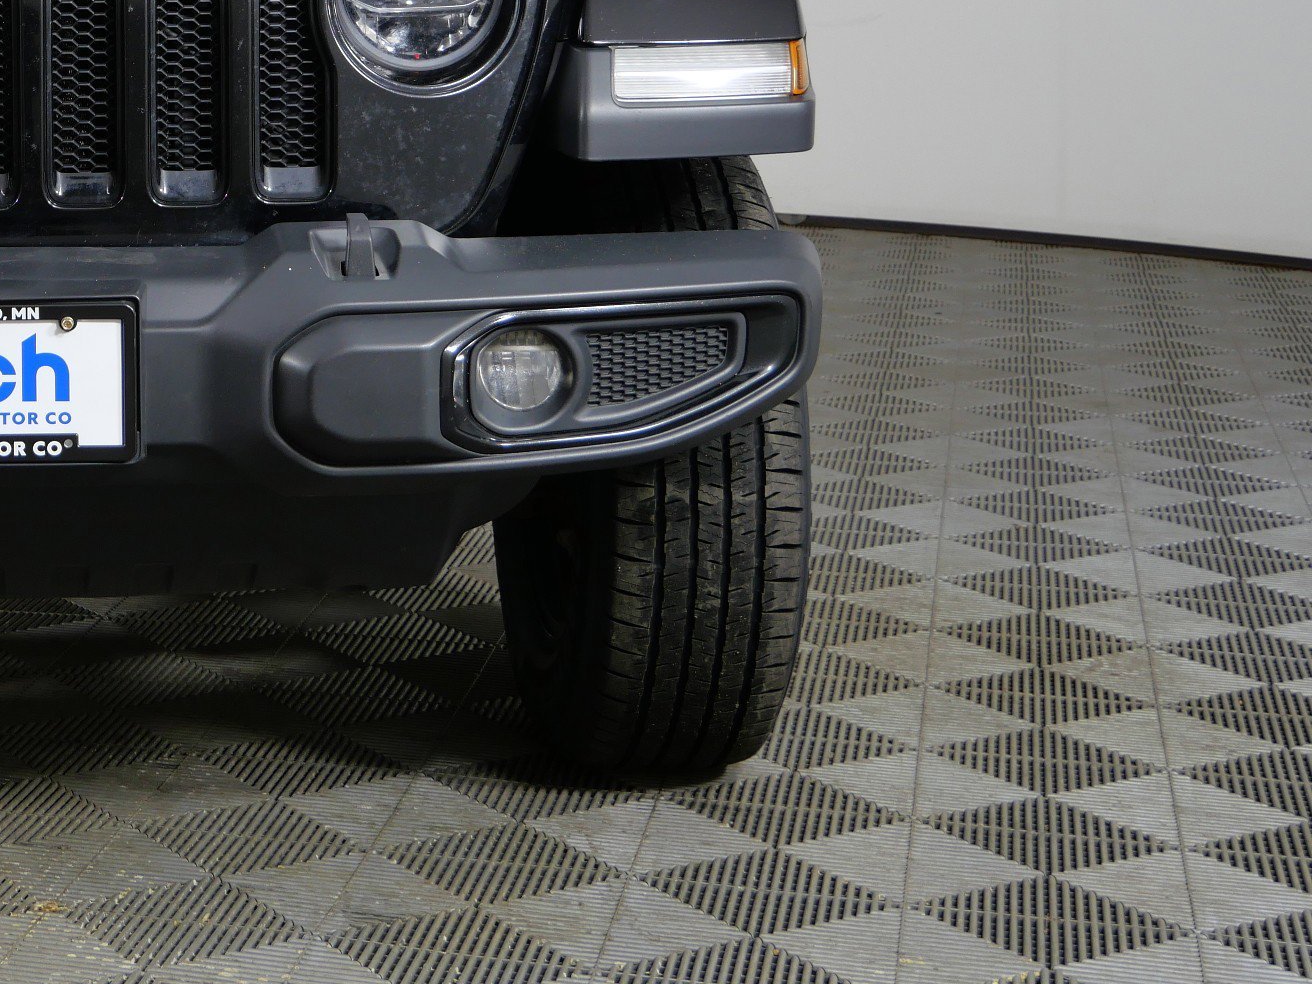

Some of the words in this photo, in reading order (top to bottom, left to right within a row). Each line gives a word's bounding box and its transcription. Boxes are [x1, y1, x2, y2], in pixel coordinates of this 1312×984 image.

[12, 307, 39, 319] MN
[46, 412, 71, 424] CO
[33, 441, 62, 456] CO
